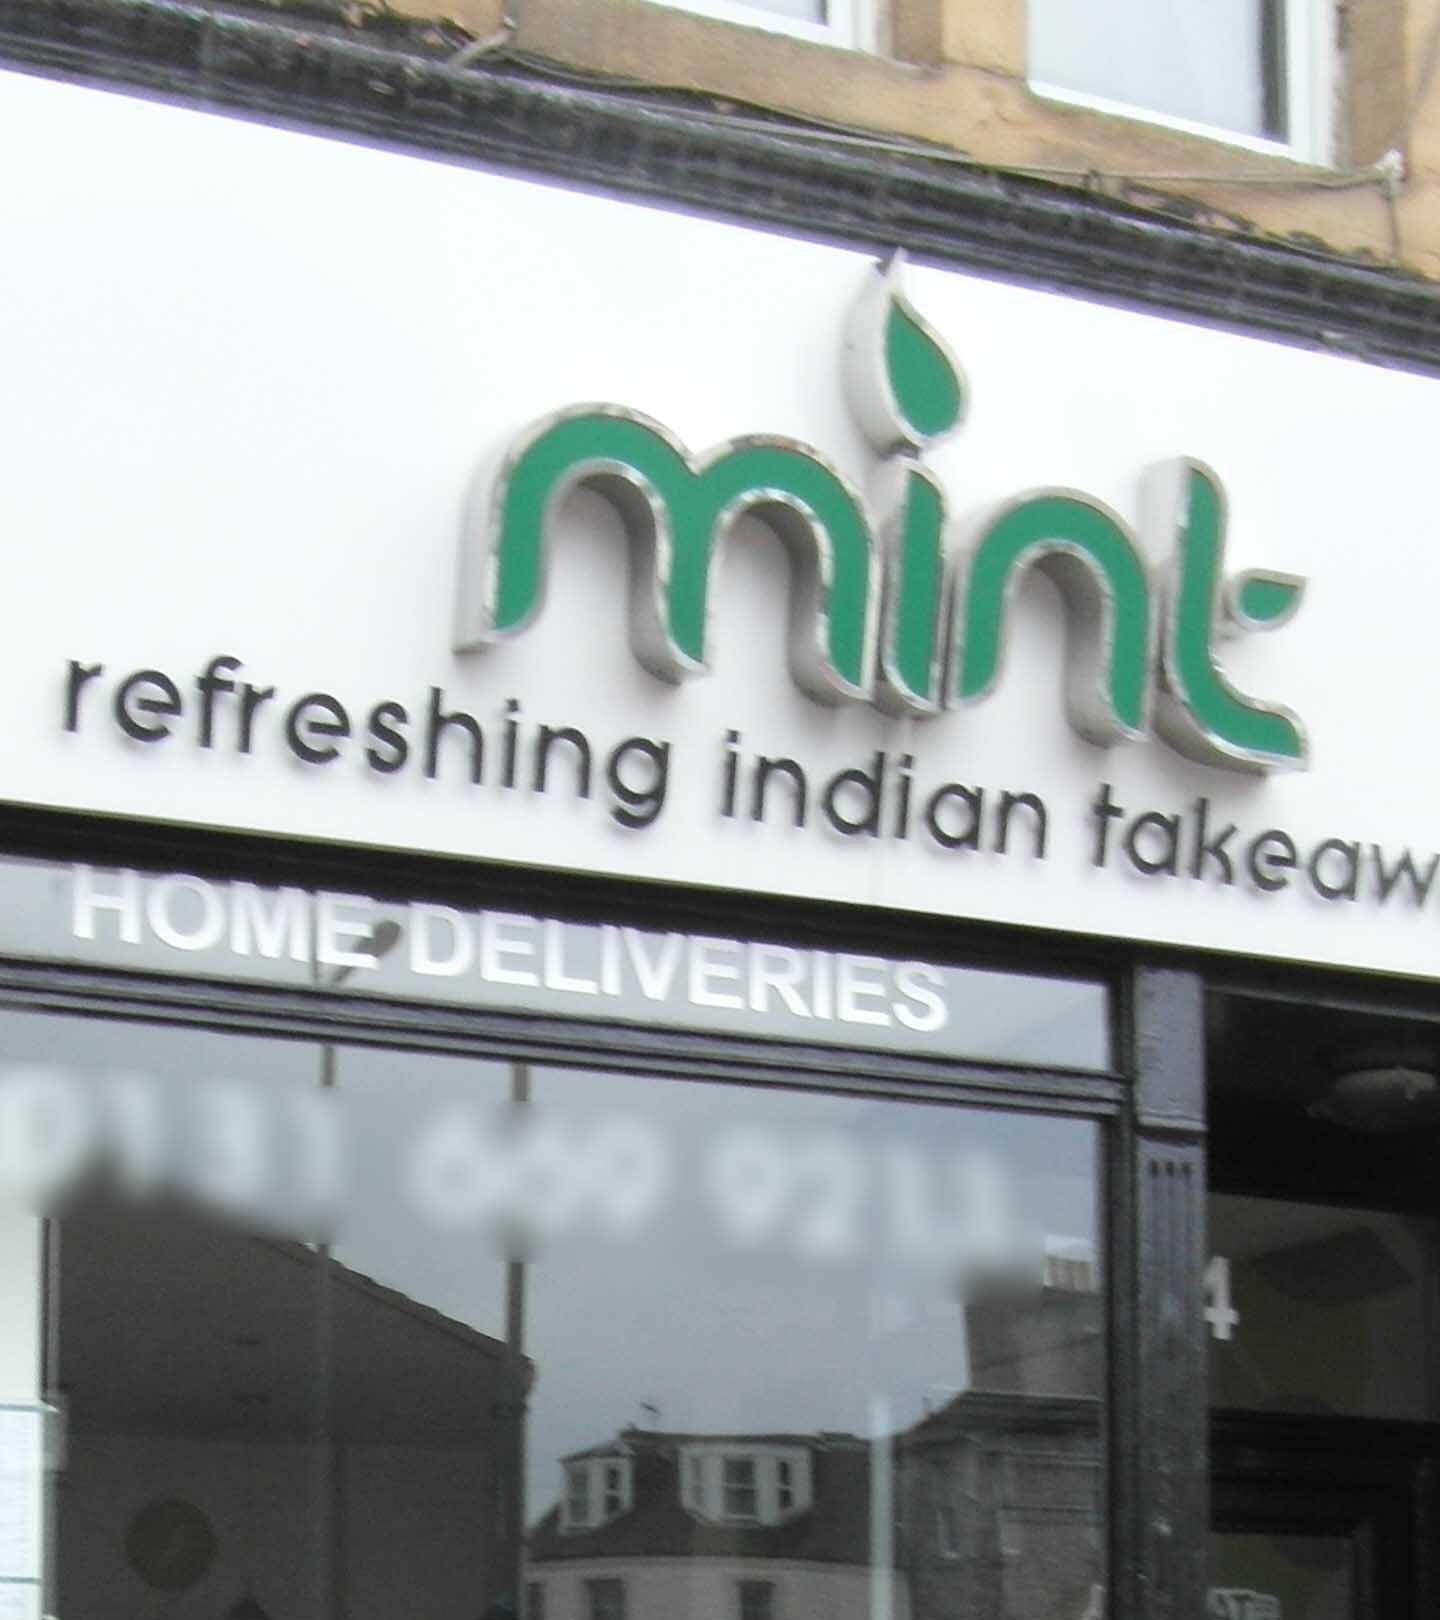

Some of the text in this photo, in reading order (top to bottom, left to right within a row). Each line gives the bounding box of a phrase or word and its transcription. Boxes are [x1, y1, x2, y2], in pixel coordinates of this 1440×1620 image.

[452, 248, 1310, 774] mint
[63, 655, 672, 830] refreshing
[723, 728, 1048, 860] indian
[70, 862, 952, 1034] HOME DELIVERIES
